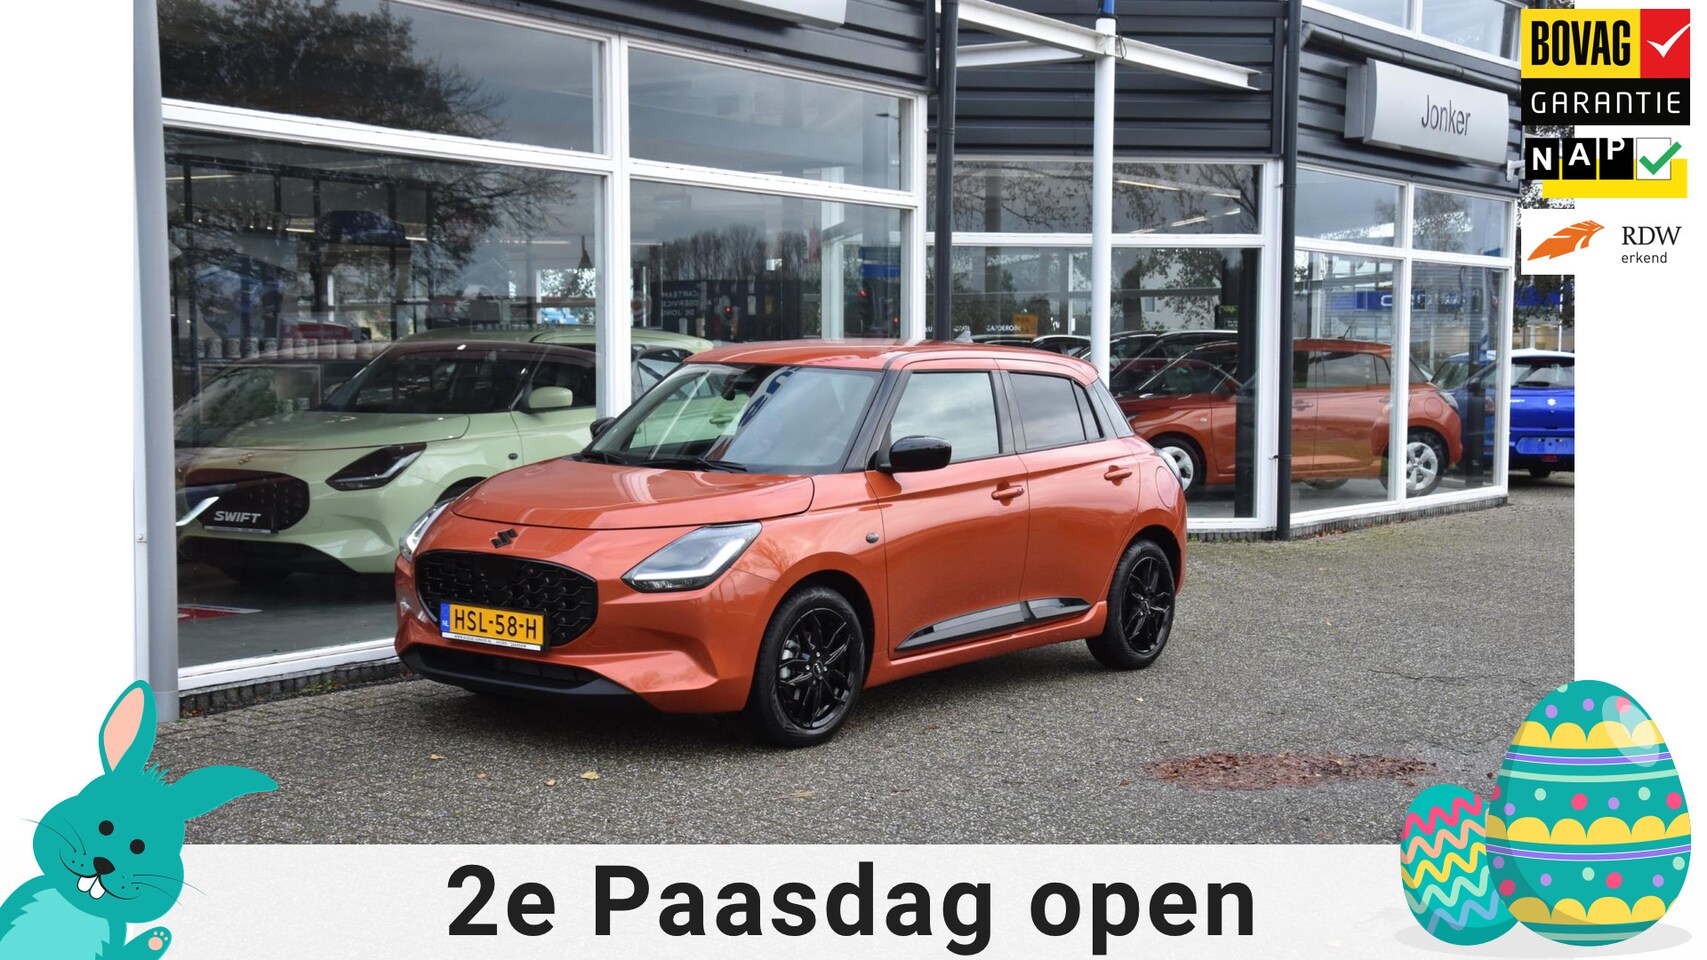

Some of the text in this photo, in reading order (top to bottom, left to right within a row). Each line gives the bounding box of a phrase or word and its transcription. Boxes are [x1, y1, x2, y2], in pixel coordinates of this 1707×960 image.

[1421, 94, 1471, 136] Jonker
[213, 510, 262, 523] SWIFT
[454, 608, 537, 640] HSL-58-H
